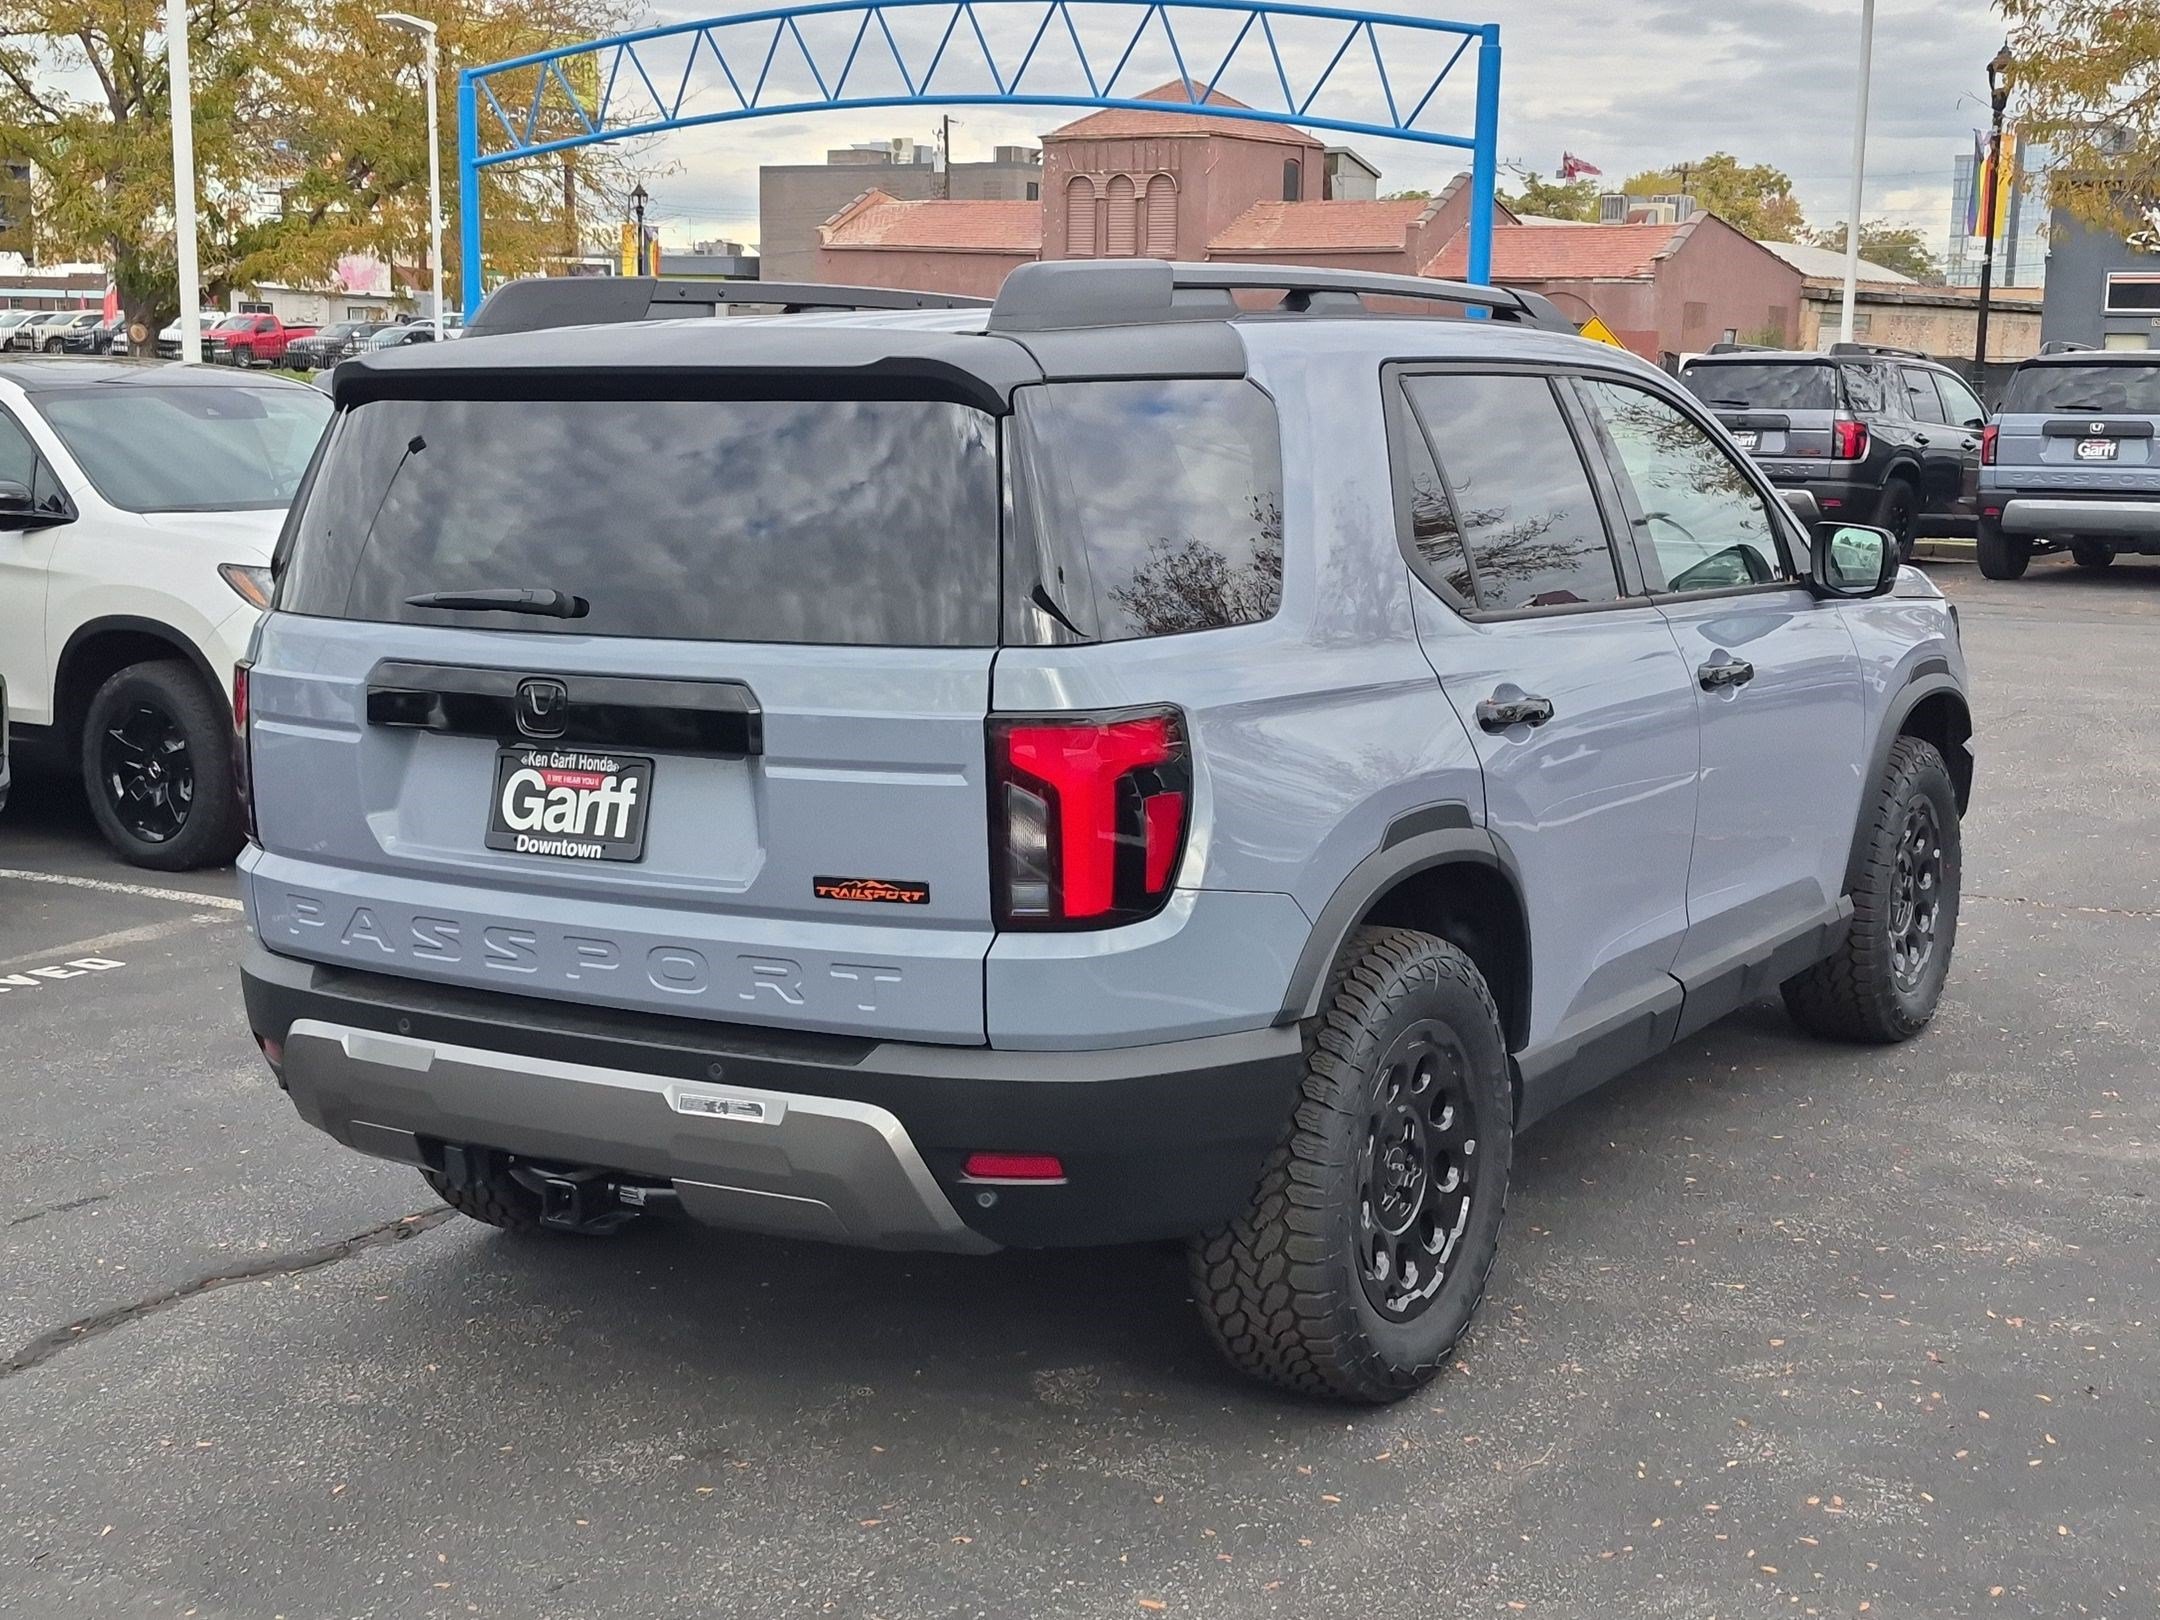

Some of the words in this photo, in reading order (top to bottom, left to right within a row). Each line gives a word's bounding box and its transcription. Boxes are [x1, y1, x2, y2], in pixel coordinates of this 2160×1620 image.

[2078, 442, 2117, 456] Garff
[528, 751, 548, 767] Ken
[550, 752, 578, 769] Garff
[578, 755, 614, 772] Honda
[502, 768, 638, 838] Garff
[517, 835, 602, 859] Downtown
[816, 886, 925, 903] TRAILSPORT
[284, 893, 903, 1011] PASSPORT
